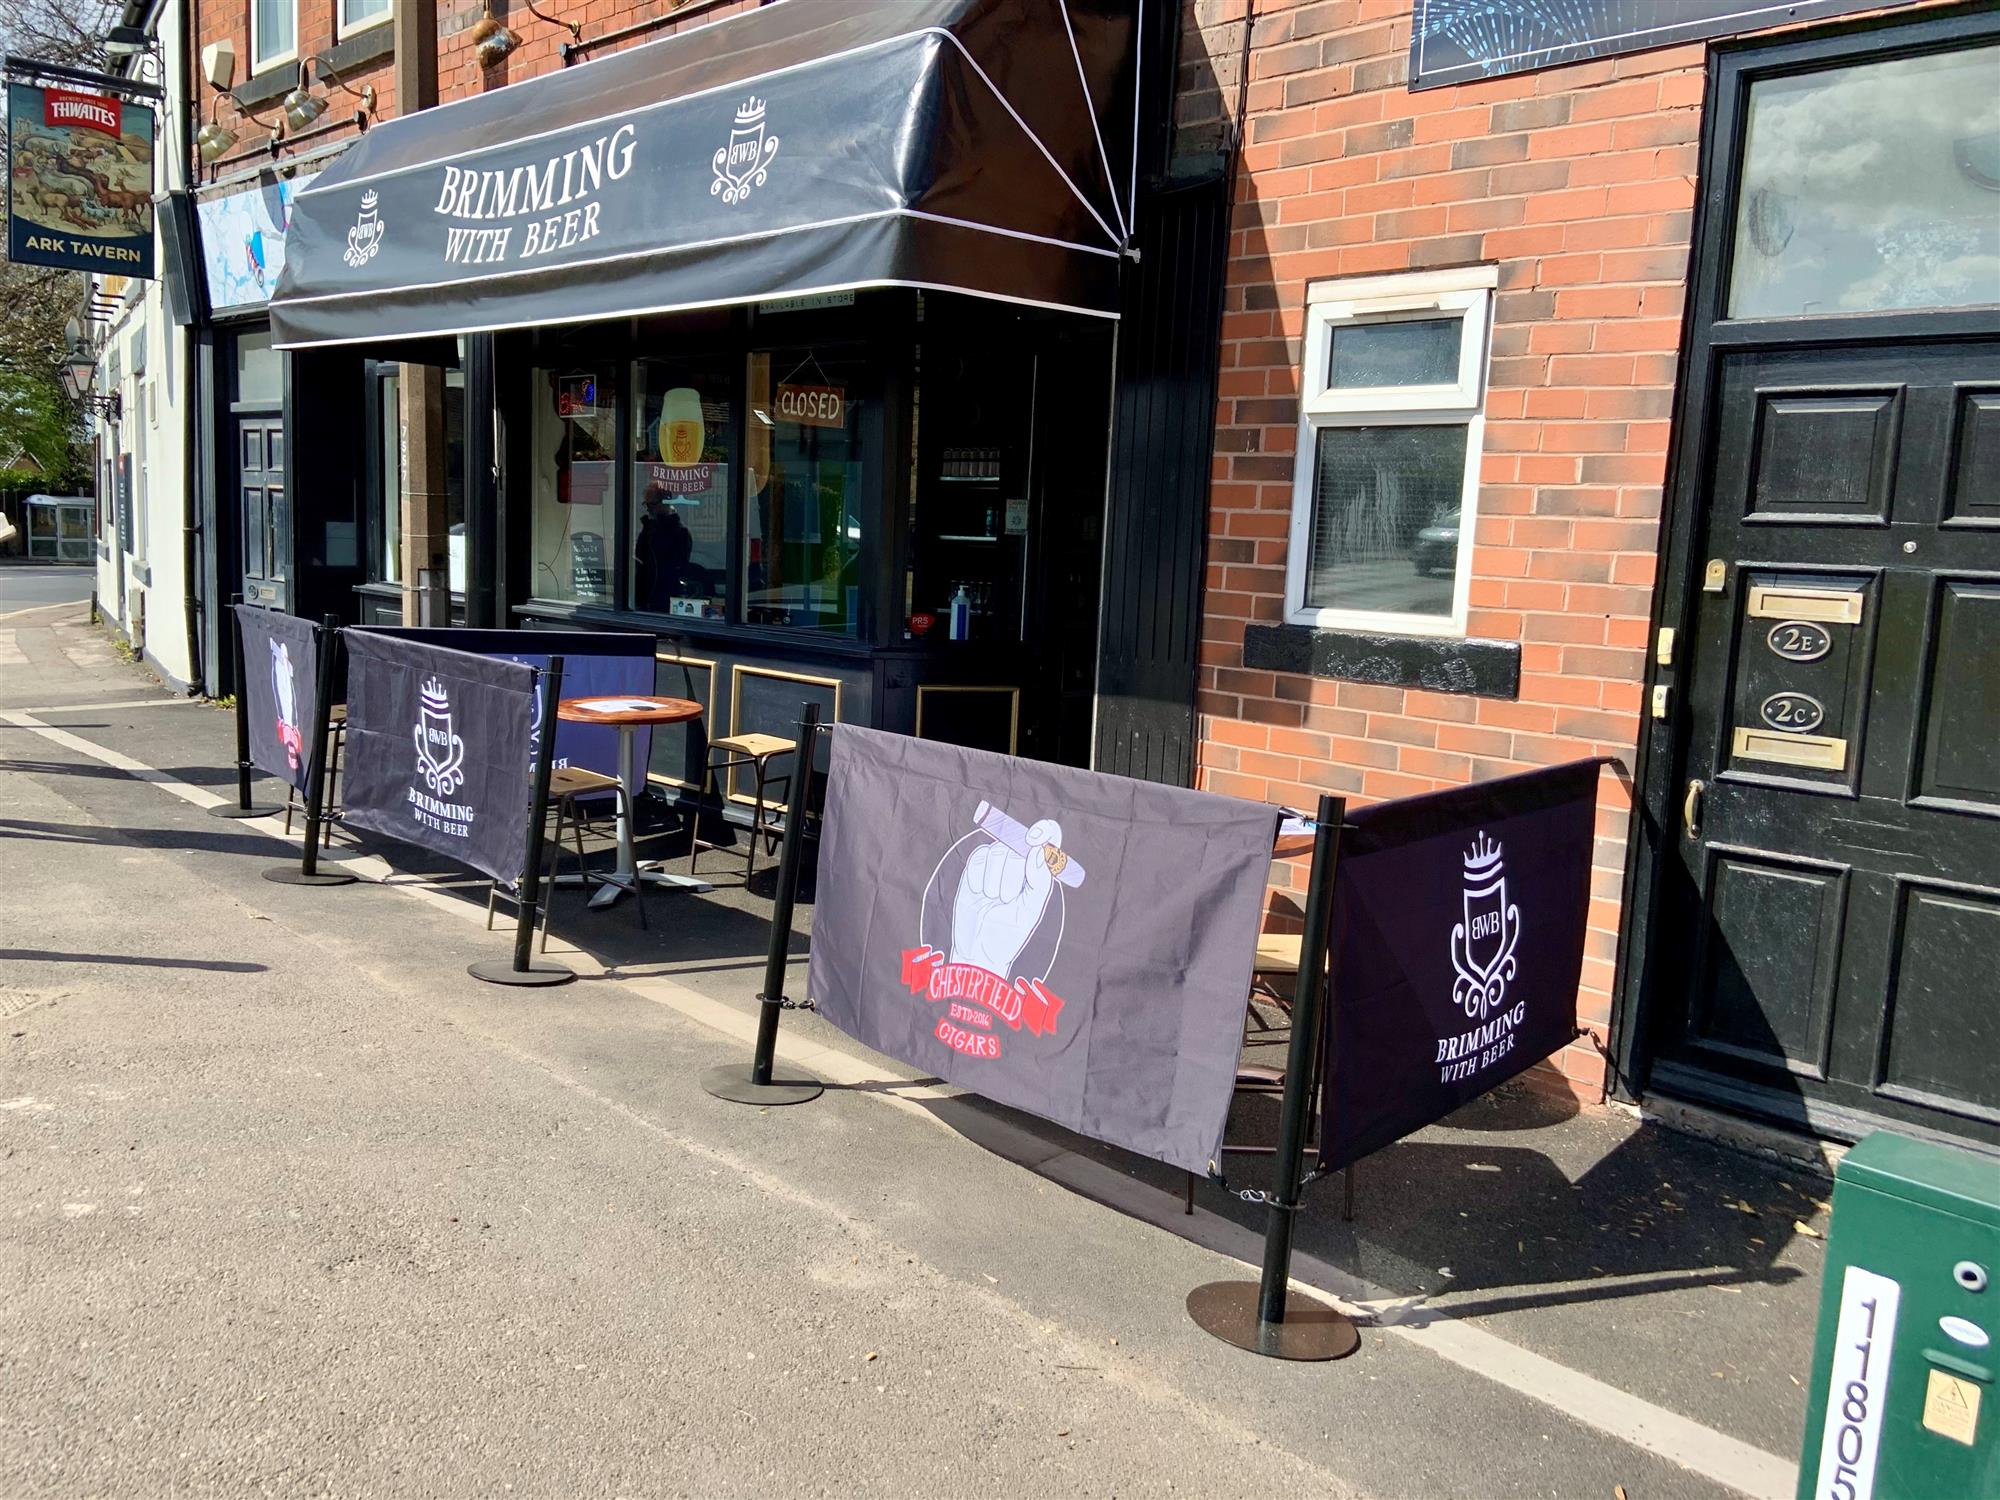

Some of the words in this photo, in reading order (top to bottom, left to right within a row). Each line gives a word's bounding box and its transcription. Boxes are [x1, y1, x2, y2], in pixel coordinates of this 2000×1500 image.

[51, 101, 117, 128] THWAITES
[434, 123, 638, 220] BRIMMING
[443, 226, 513, 265] WITH
[519, 202, 601, 259] BEER
[25, 235, 65, 253] ARK
[70, 241, 141, 263] TAVERN
[811, 296, 821, 306] IN
[827, 293, 854, 305] STORE
[781, 391, 840, 420] CLOSED
[652, 465, 710, 480] BRIMMING
[657, 480, 680, 492] WITH
[682, 481, 705, 492] BEER
[912, 616, 929, 625] PRS
[1782, 628, 1813, 652] 2E
[1774, 700, 1807, 724] 2C
[408, 786, 475, 823] BRIMMING
[414, 807, 441, 831] WITH
[443, 820, 469, 838] BEER
[929, 964, 1023, 1022] CHESTERFIELD
[939, 1022, 997, 1056] CIGARS
[1435, 999, 1526, 1063] BRIMMING
[1440, 1056, 1477, 1085] WITH
[1481, 1033, 1515, 1071] BEER
